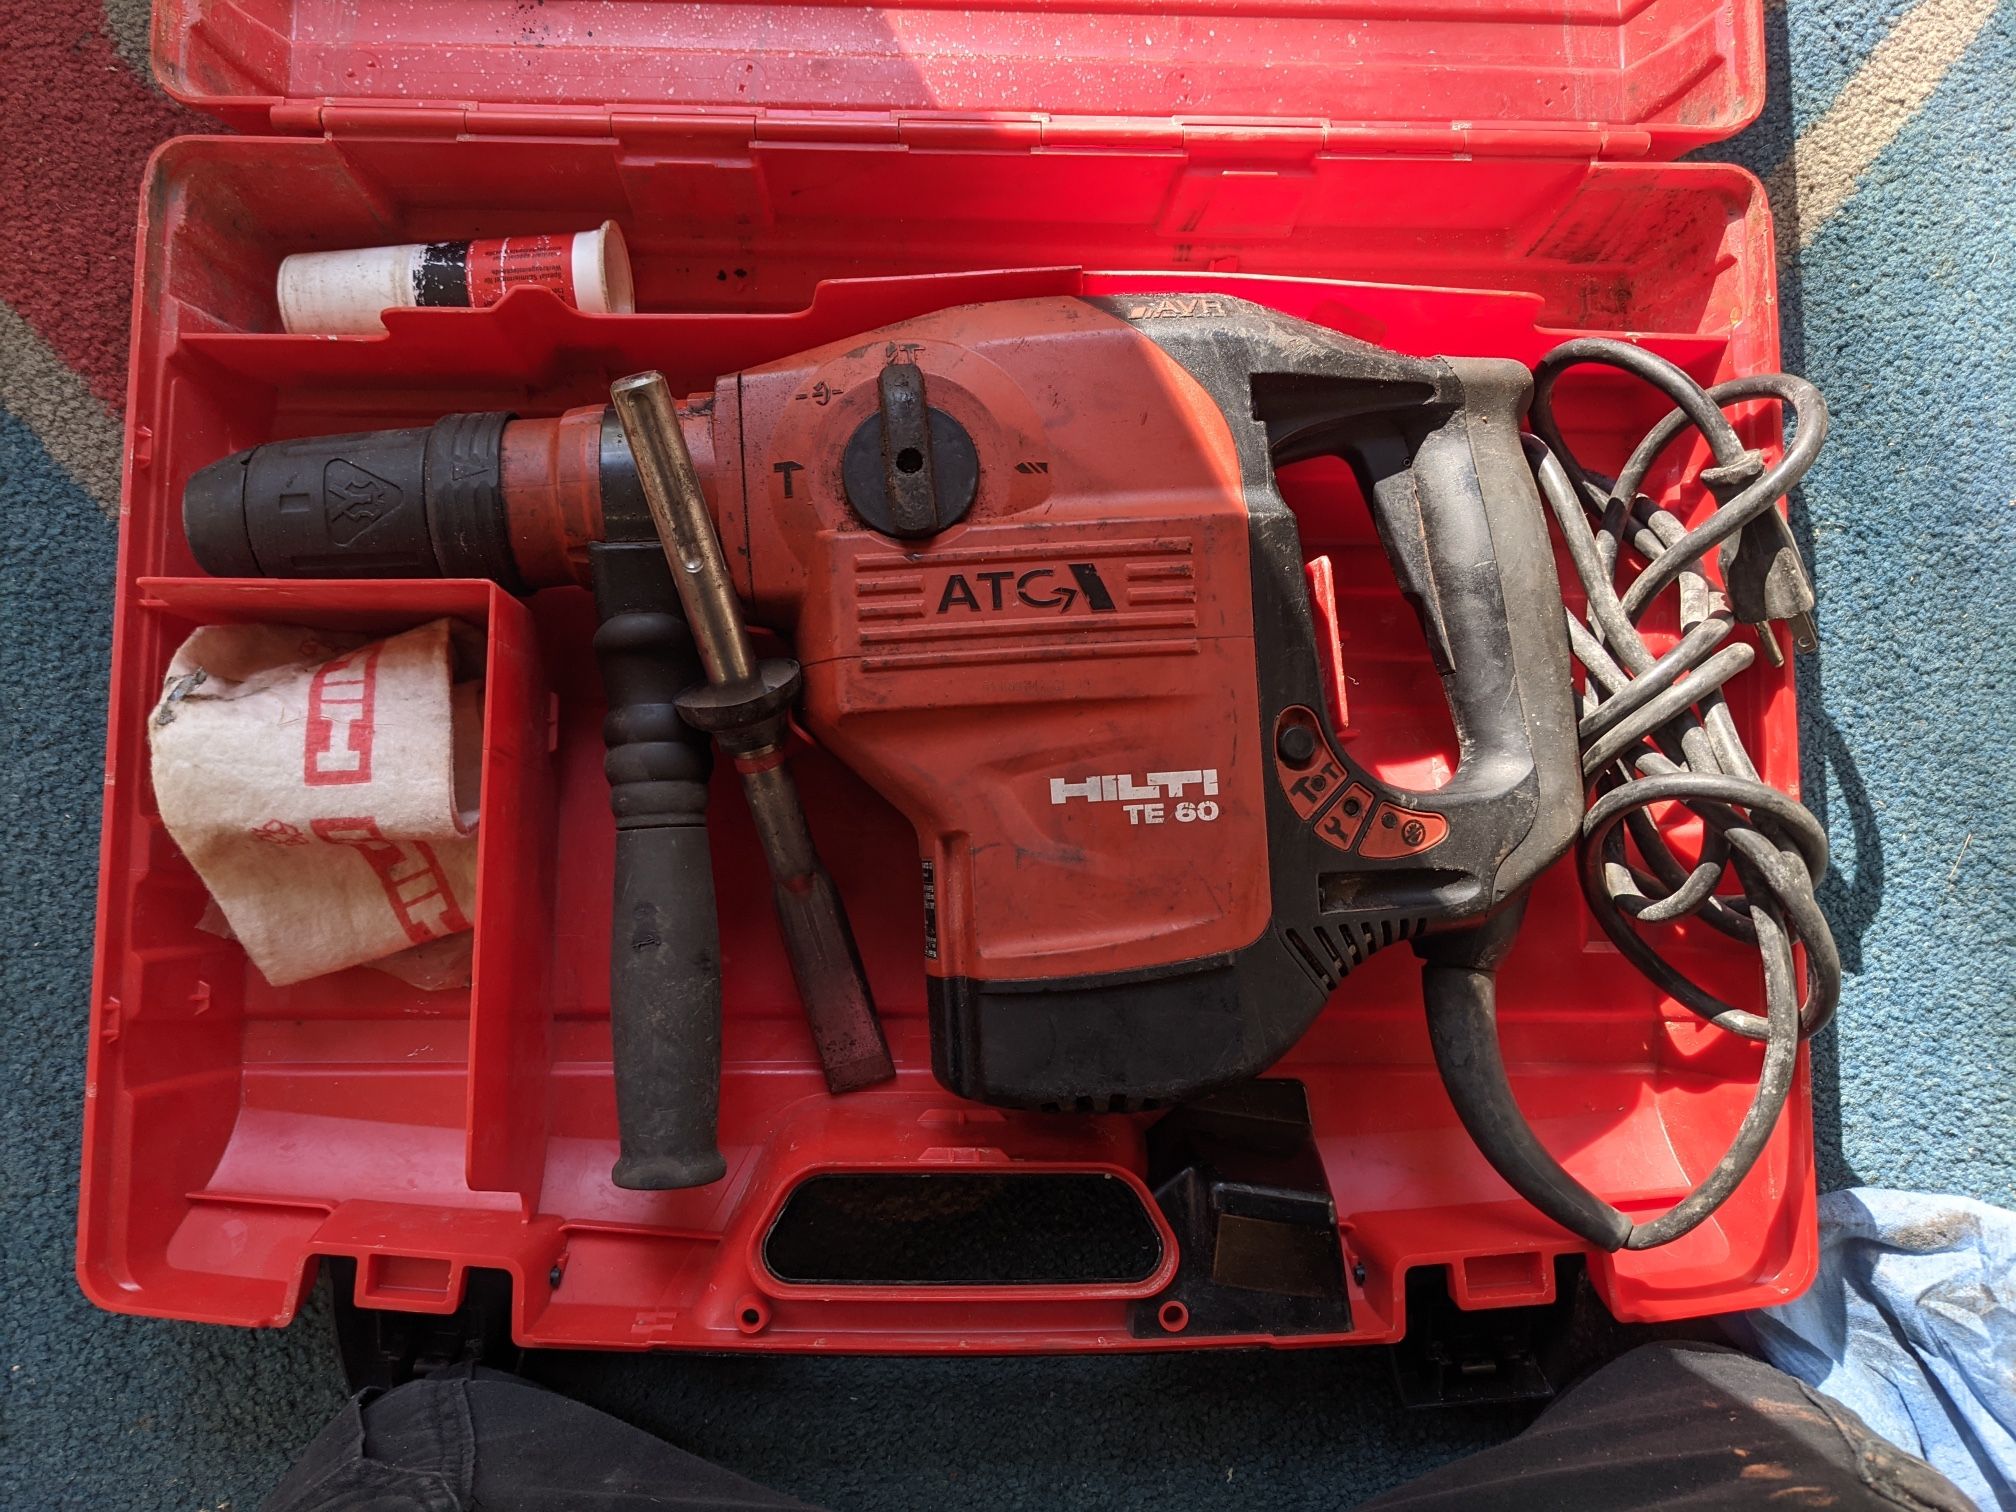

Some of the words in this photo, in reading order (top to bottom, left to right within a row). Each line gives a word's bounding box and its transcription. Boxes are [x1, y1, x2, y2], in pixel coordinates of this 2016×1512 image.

[1154, 299, 1227, 319] AVR
[1049, 769, 1219, 804] HILTI
[1123, 803, 1164, 824] TE
[1174, 800, 1220, 823] 60
